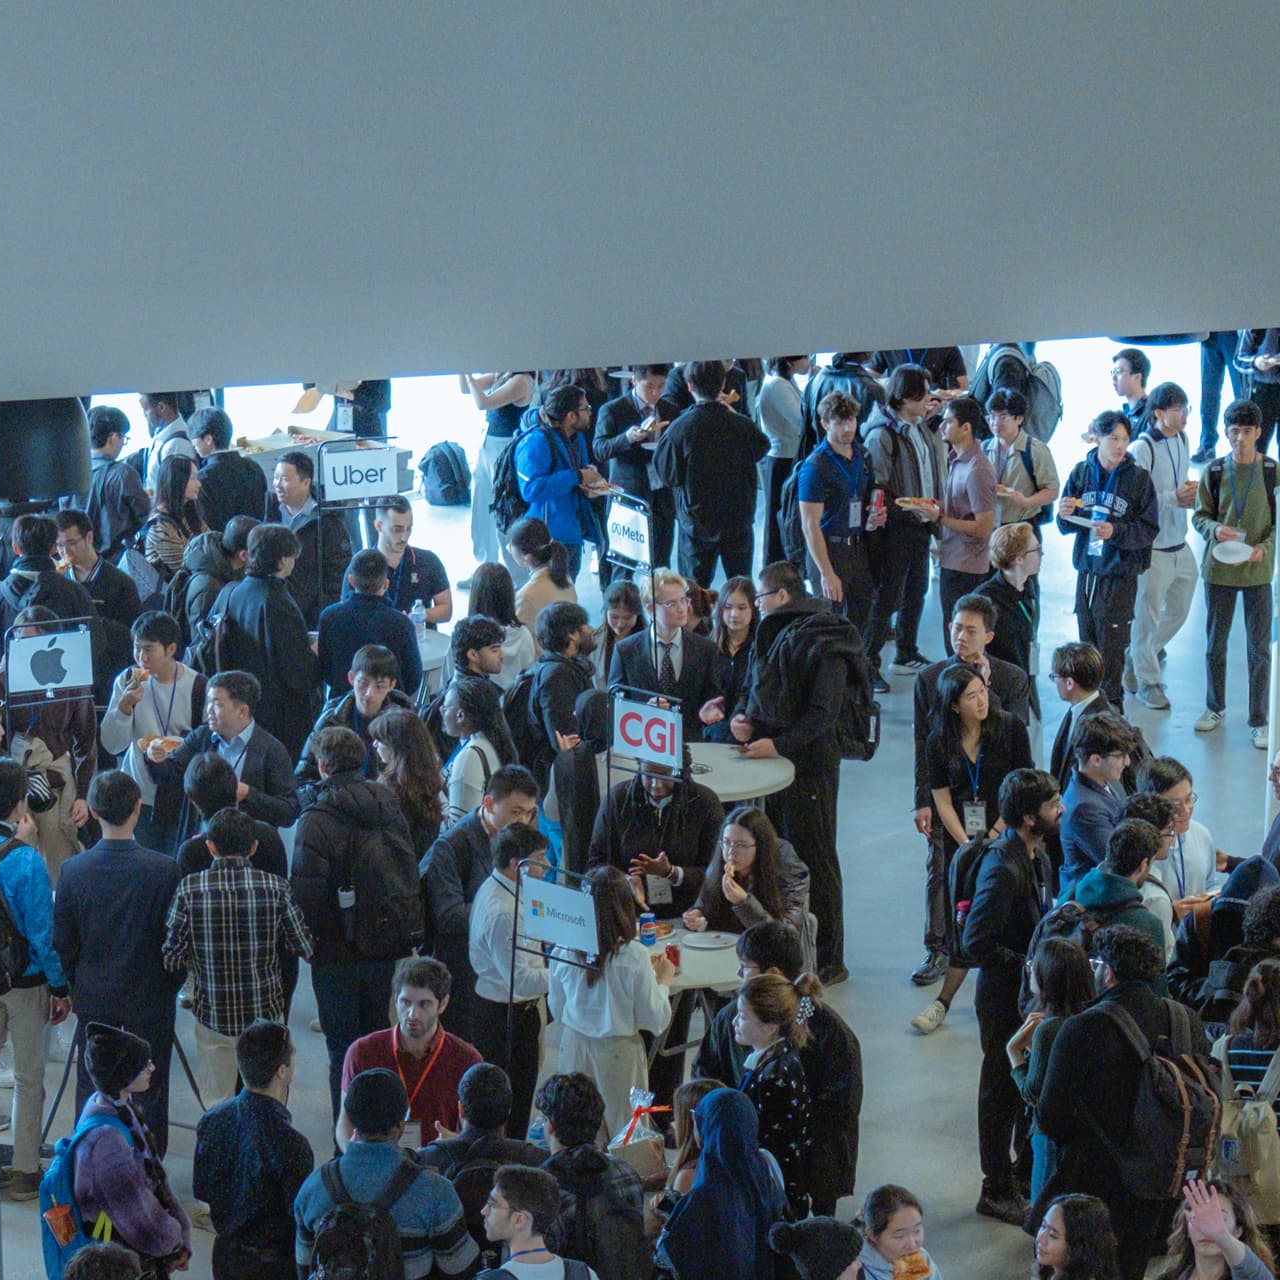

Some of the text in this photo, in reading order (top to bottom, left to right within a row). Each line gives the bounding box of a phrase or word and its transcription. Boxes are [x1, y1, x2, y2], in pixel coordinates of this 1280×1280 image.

[332, 465, 387, 486] Uber
[622, 525, 645, 544] Meta
[619, 712, 676, 757] CGI
[546, 906, 586, 927] Microsoft
